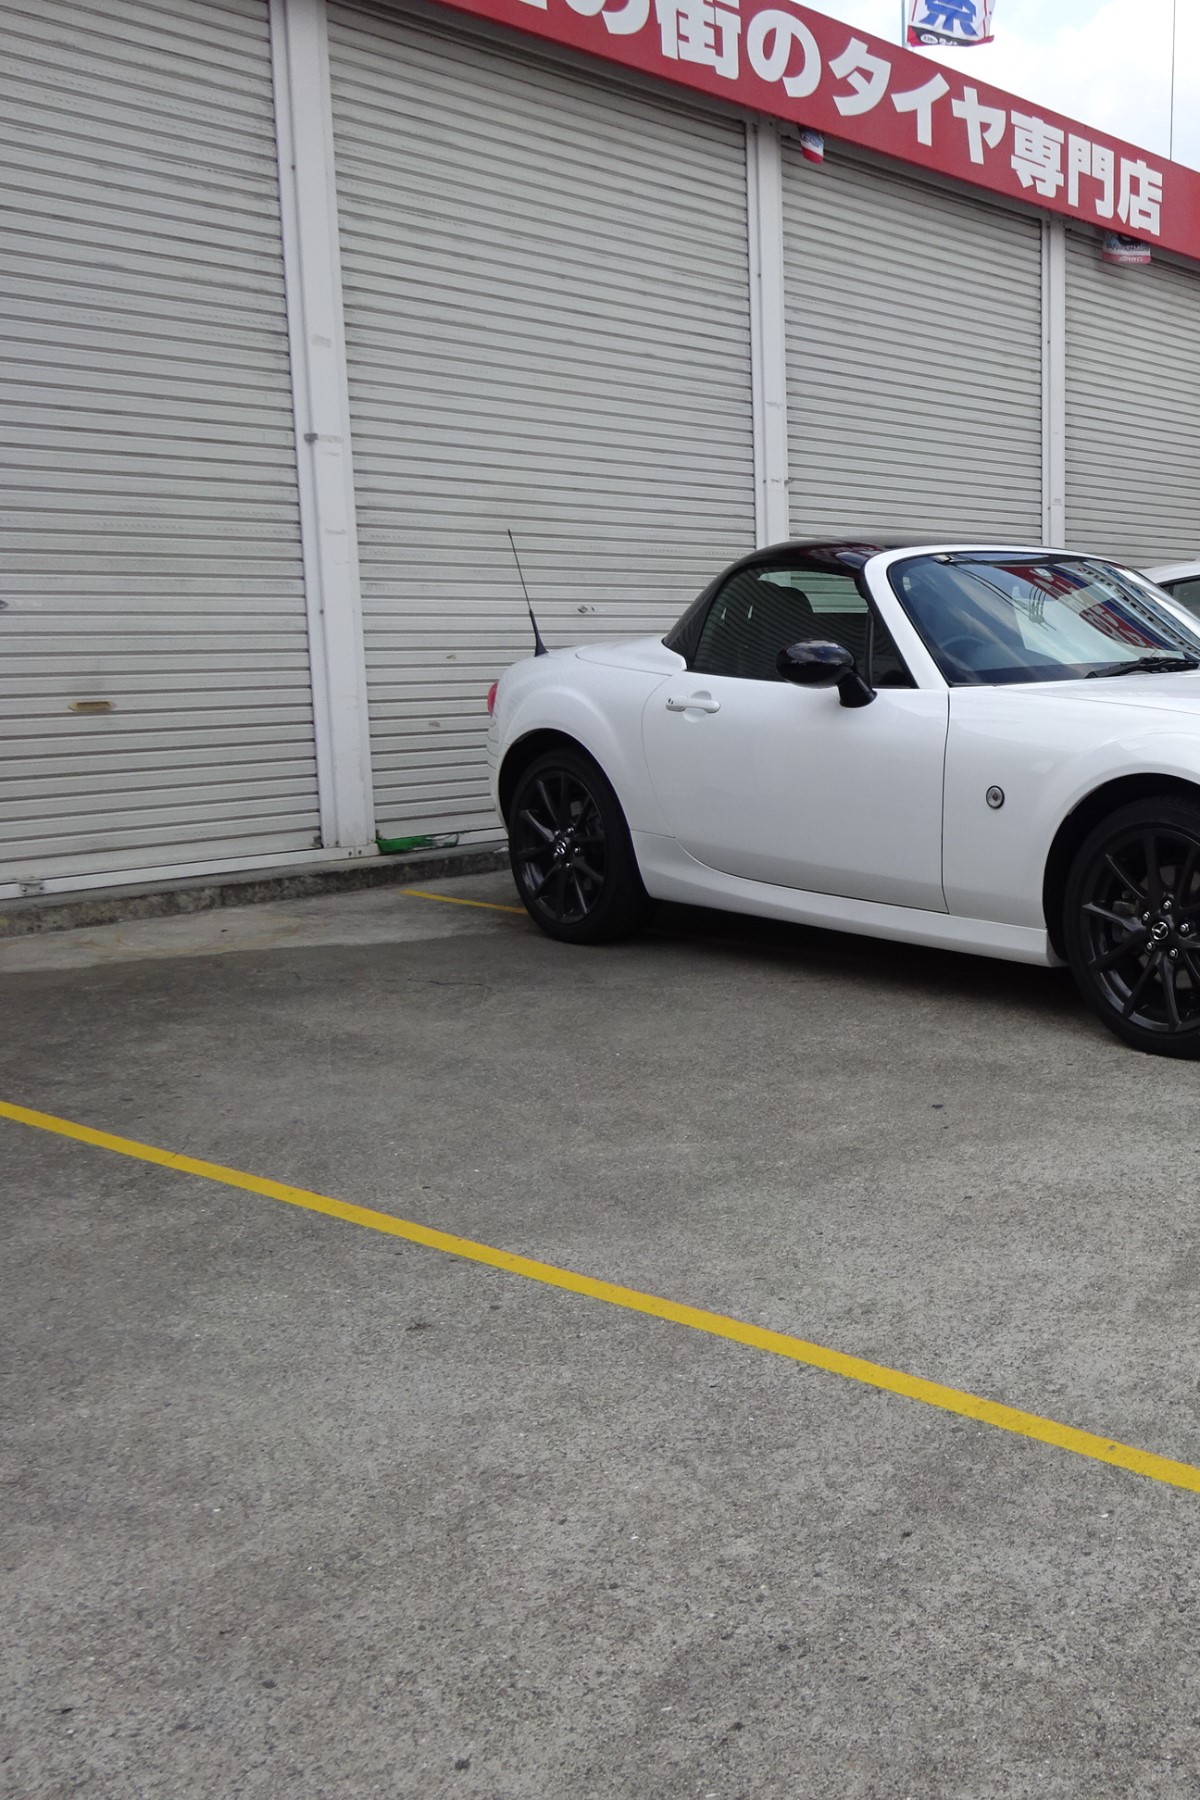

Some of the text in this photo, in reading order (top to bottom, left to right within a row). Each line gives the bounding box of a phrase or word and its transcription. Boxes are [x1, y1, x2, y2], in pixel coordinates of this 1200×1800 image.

[518, 0, 1163, 237] 街のタイヤ専門店
